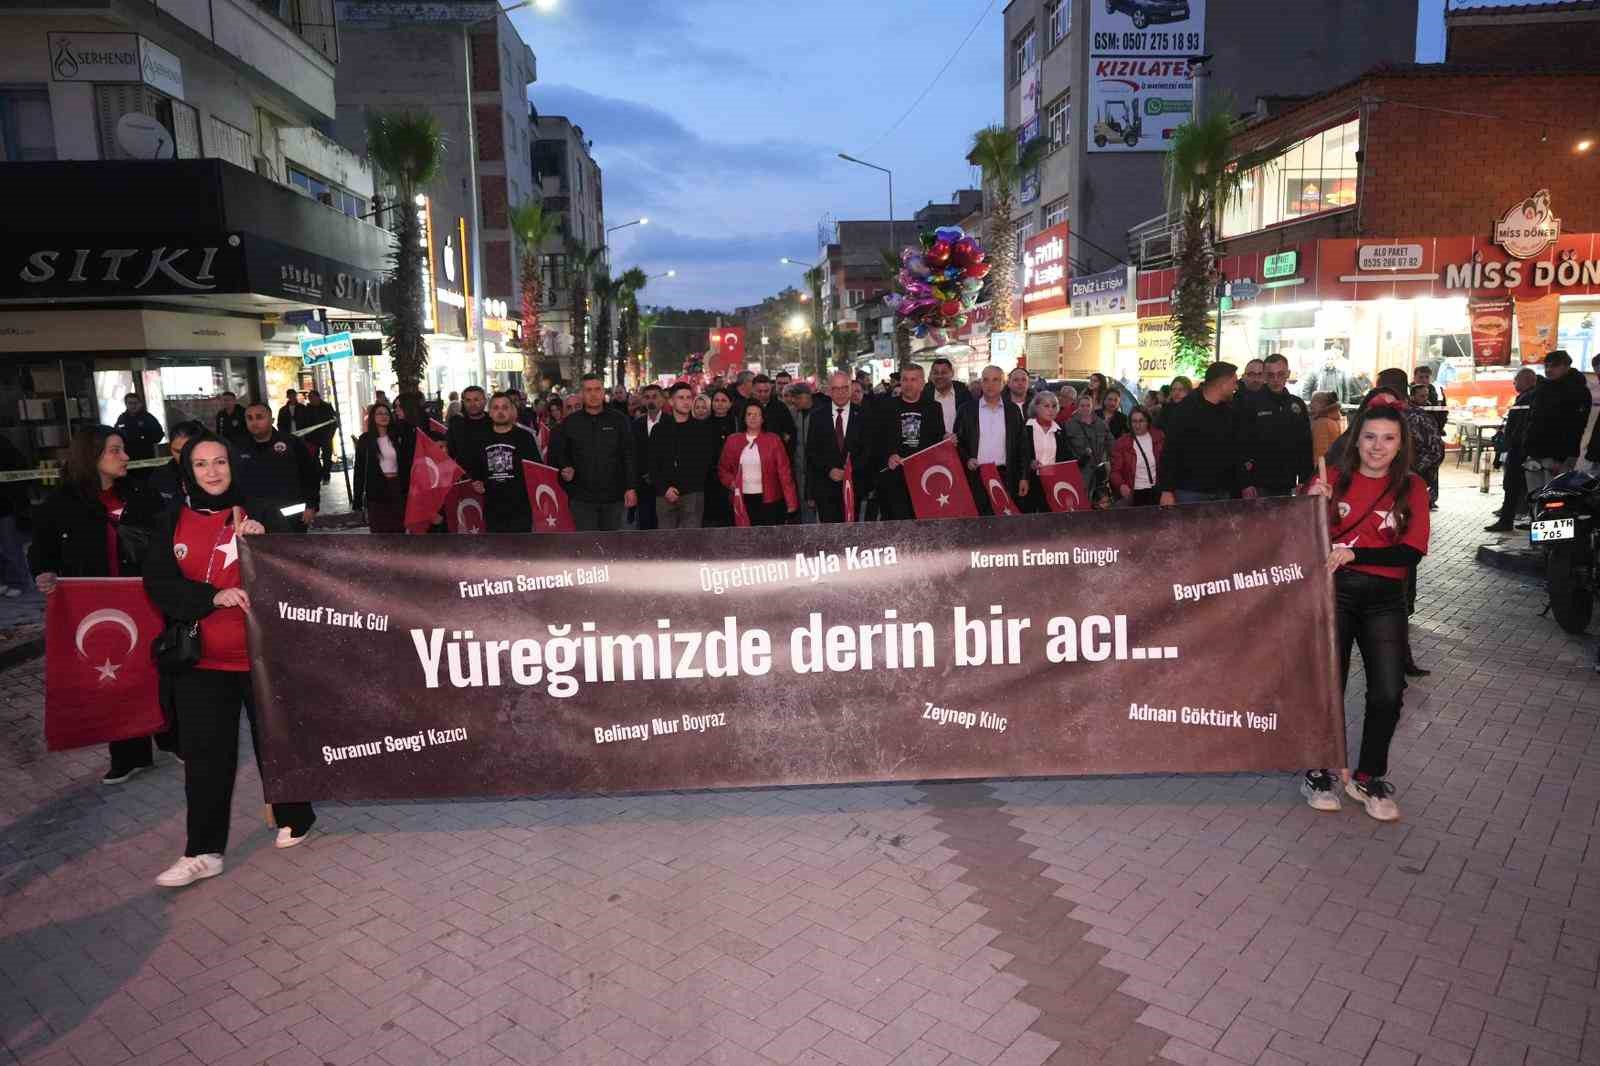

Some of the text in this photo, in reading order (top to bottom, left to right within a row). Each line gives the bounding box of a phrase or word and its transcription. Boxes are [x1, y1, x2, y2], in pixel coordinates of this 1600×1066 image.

[1094, 32, 1199, 50] GSM: 0507 275 18 93
[19, 246, 219, 290] SITKI
[1446, 250, 1522, 289] MİSS
[795, 550, 840, 582] Ayla
[845, 546, 897, 571] Kara
[971, 547, 1119, 568] Kerem Erdem Güngör
[459, 565, 609, 598] Furkan Sancak Balal
[1173, 563, 1304, 603] Bayram Nabi Şişik
[278, 601, 388, 633] Yusuf Tarık Gül
[410, 605, 1178, 698] Yüreğimizde derin bir acı...
[594, 712, 727, 744] Belinay Nur Boyraz
[921, 702, 1008, 733] Zeynep Kılıç
[1129, 703, 1278, 732] Adnan Göktürk Yeşil
[322, 727, 468, 765] Şuranur Sevgi Kazıcı
